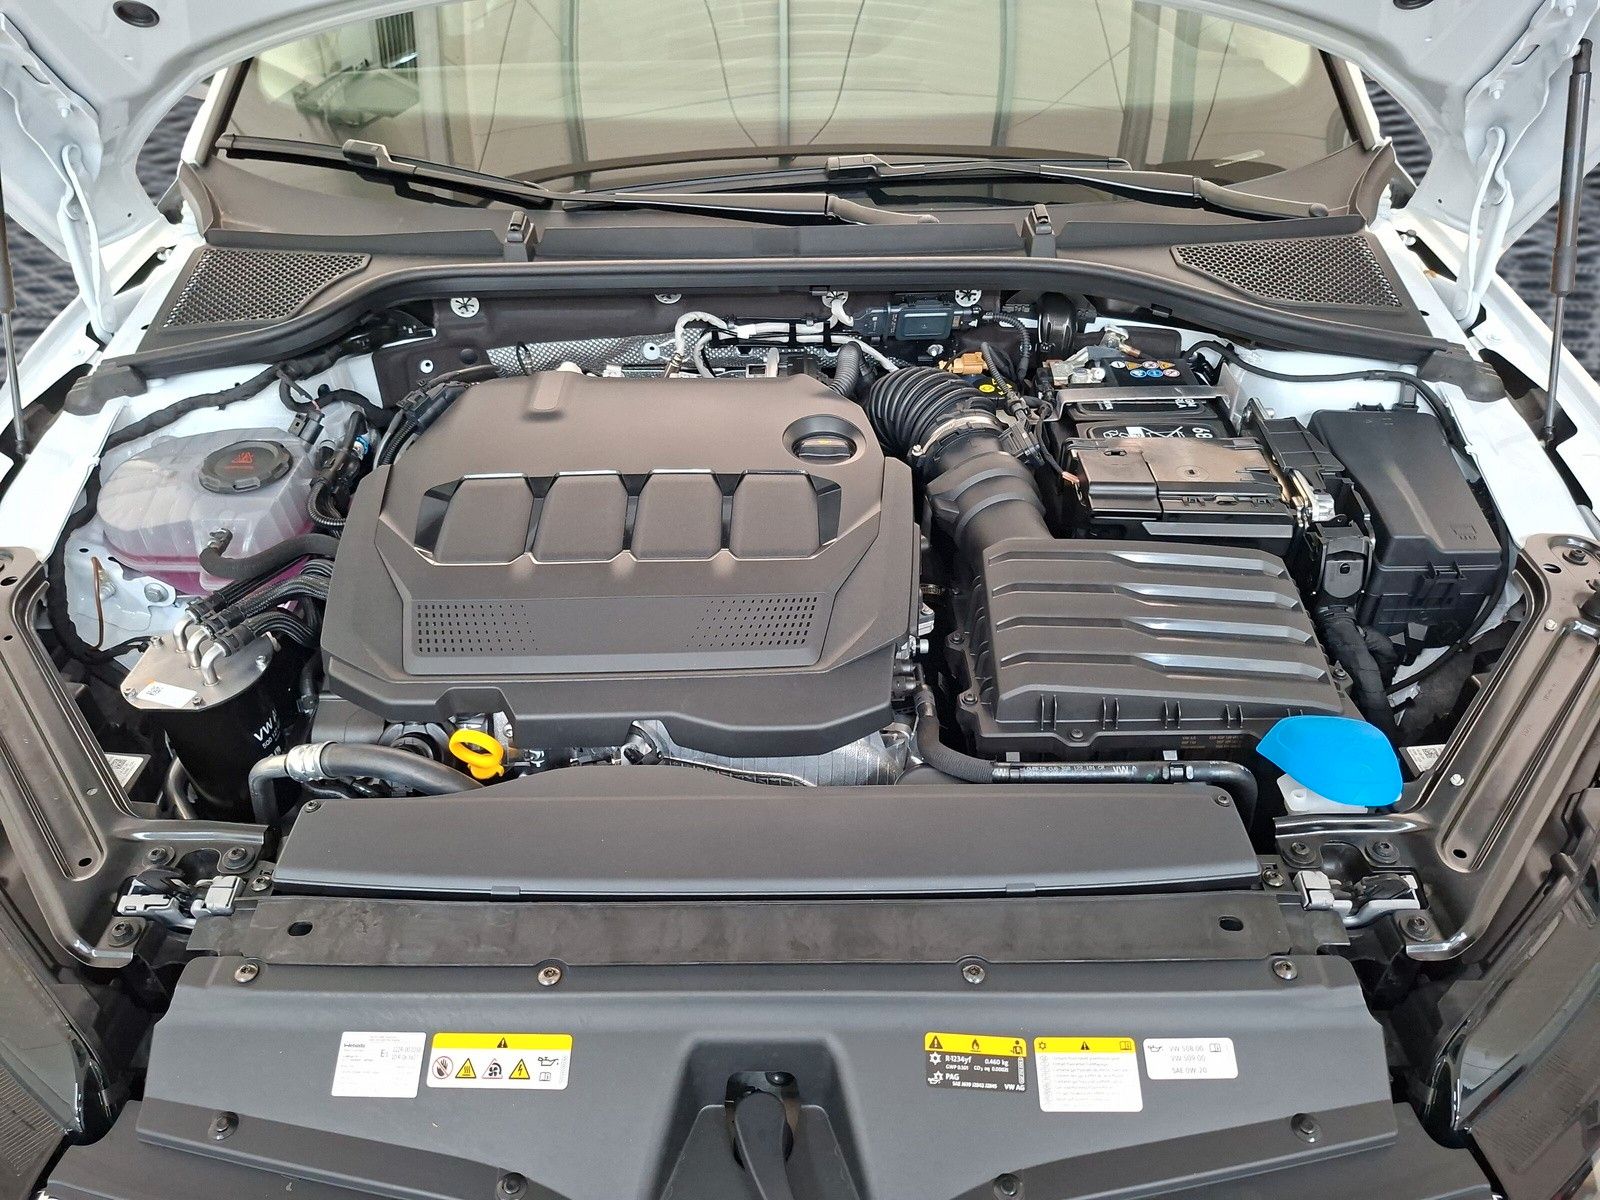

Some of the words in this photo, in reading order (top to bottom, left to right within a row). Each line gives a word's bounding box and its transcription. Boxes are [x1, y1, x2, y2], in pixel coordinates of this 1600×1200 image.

[253, 717, 273, 741] VW
[1112, 765, 1129, 775] VW
[945, 1055, 972, 1065] R-1234yf
[1001, 1059, 1009, 1067] kg
[945, 1073, 960, 1081] PAG
[1004, 1083, 1016, 1091] VW
[1016, 1084, 1026, 1092] AG
